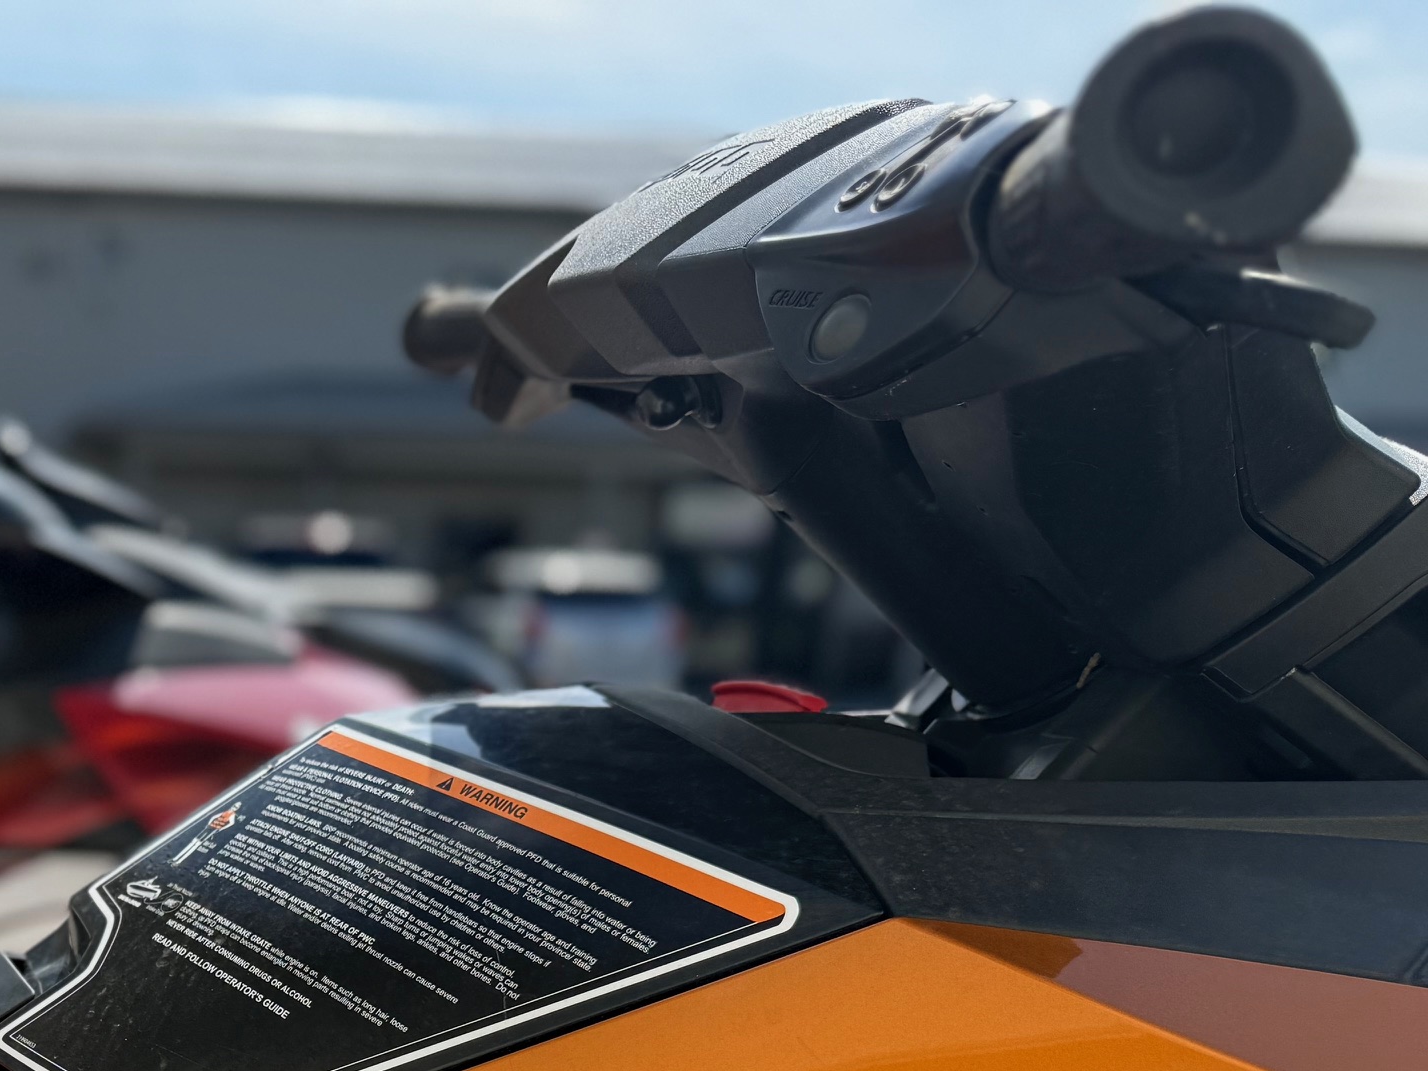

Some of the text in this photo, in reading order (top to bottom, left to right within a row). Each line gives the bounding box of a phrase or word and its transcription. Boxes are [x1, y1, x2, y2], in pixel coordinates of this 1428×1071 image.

[769, 289, 824, 309] CRUISE
[459, 783, 528, 820] WARNING
[352, 868, 371, 881] PWC
[449, 918, 476, 936] children
[495, 838, 528, 856] approved
[525, 851, 543, 864] PFD
[540, 859, 557, 871] that
[561, 870, 591, 888] suitable
[587, 881, 601, 893] for
[597, 888, 633, 908] personal
[495, 869, 510, 880] into
[508, 875, 528, 888] lower
[526, 884, 546, 899] body
[543, 894, 582, 918] opening(s)
[588, 917, 612, 933] males
[326, 872, 370, 898] AGGRESSIVE
[366, 892, 410, 919] MANEUVERS
[436, 929, 450, 940] the
[447, 936, 462, 947] risk
[467, 946, 483, 959] loss
[328, 916, 350, 931] REAR
[357, 932, 377, 946] PWC
[369, 868, 386, 881] PFD
[442, 905, 479, 929] handlebars
[486, 929, 503, 942] that
[499, 937, 525, 954] engine
[523, 950, 545, 966] stops
[465, 899, 482, 912] may
[489, 912, 519, 931] required
[523, 931, 542, 944] your
[539, 940, 575, 961] province/
[481, 898, 502, 913] Know
[500, 908, 515, 919] the
[512, 915, 542, 934] operator
[541, 931, 557, 943] age
[555, 938, 573, 950] and
[569, 945, 598, 966] training
[501, 864, 528, 880] cavities
[541, 884, 564, 897] result
[569, 896, 592, 914] falling
[590, 907, 607, 920] into
[604, 915, 627, 931] water
[634, 930, 658, 948] being
[580, 923, 597, 934] and
[151, 932, 291, 1020] READ AND FOLLOW OPERATOR'S GUIDE
[165, 918, 186, 933] NEVER
[182, 928, 199, 940] RIDE
[195, 934, 217, 950] AFTER
[213, 944, 251, 970] CONSUMING
[247, 964, 273, 983] DRUGS
[279, 984, 315, 1009] ALCOHOL
[249, 934, 273, 950] GRATE
[320, 975, 339, 990] Items
[337, 986, 355, 999] such
[361, 999, 377, 1014] long
[389, 1017, 409, 1033] loose
[382, 956, 405, 972] nozzle
[402, 968, 416, 979] can
[414, 976, 437, 991] cause
[434, 987, 459, 1005] severe
[426, 933, 453, 953] jumping
[452, 949, 475, 964] wakes
[481, 966, 505, 982] waves
[503, 978, 519, 990] can
[439, 950, 454, 962] and
[452, 958, 471, 972] other
[506, 989, 521, 1001] not
[312, 981, 330, 994] parts
[327, 991, 355, 1011] resulting
[359, 1011, 383, 1027] severe
